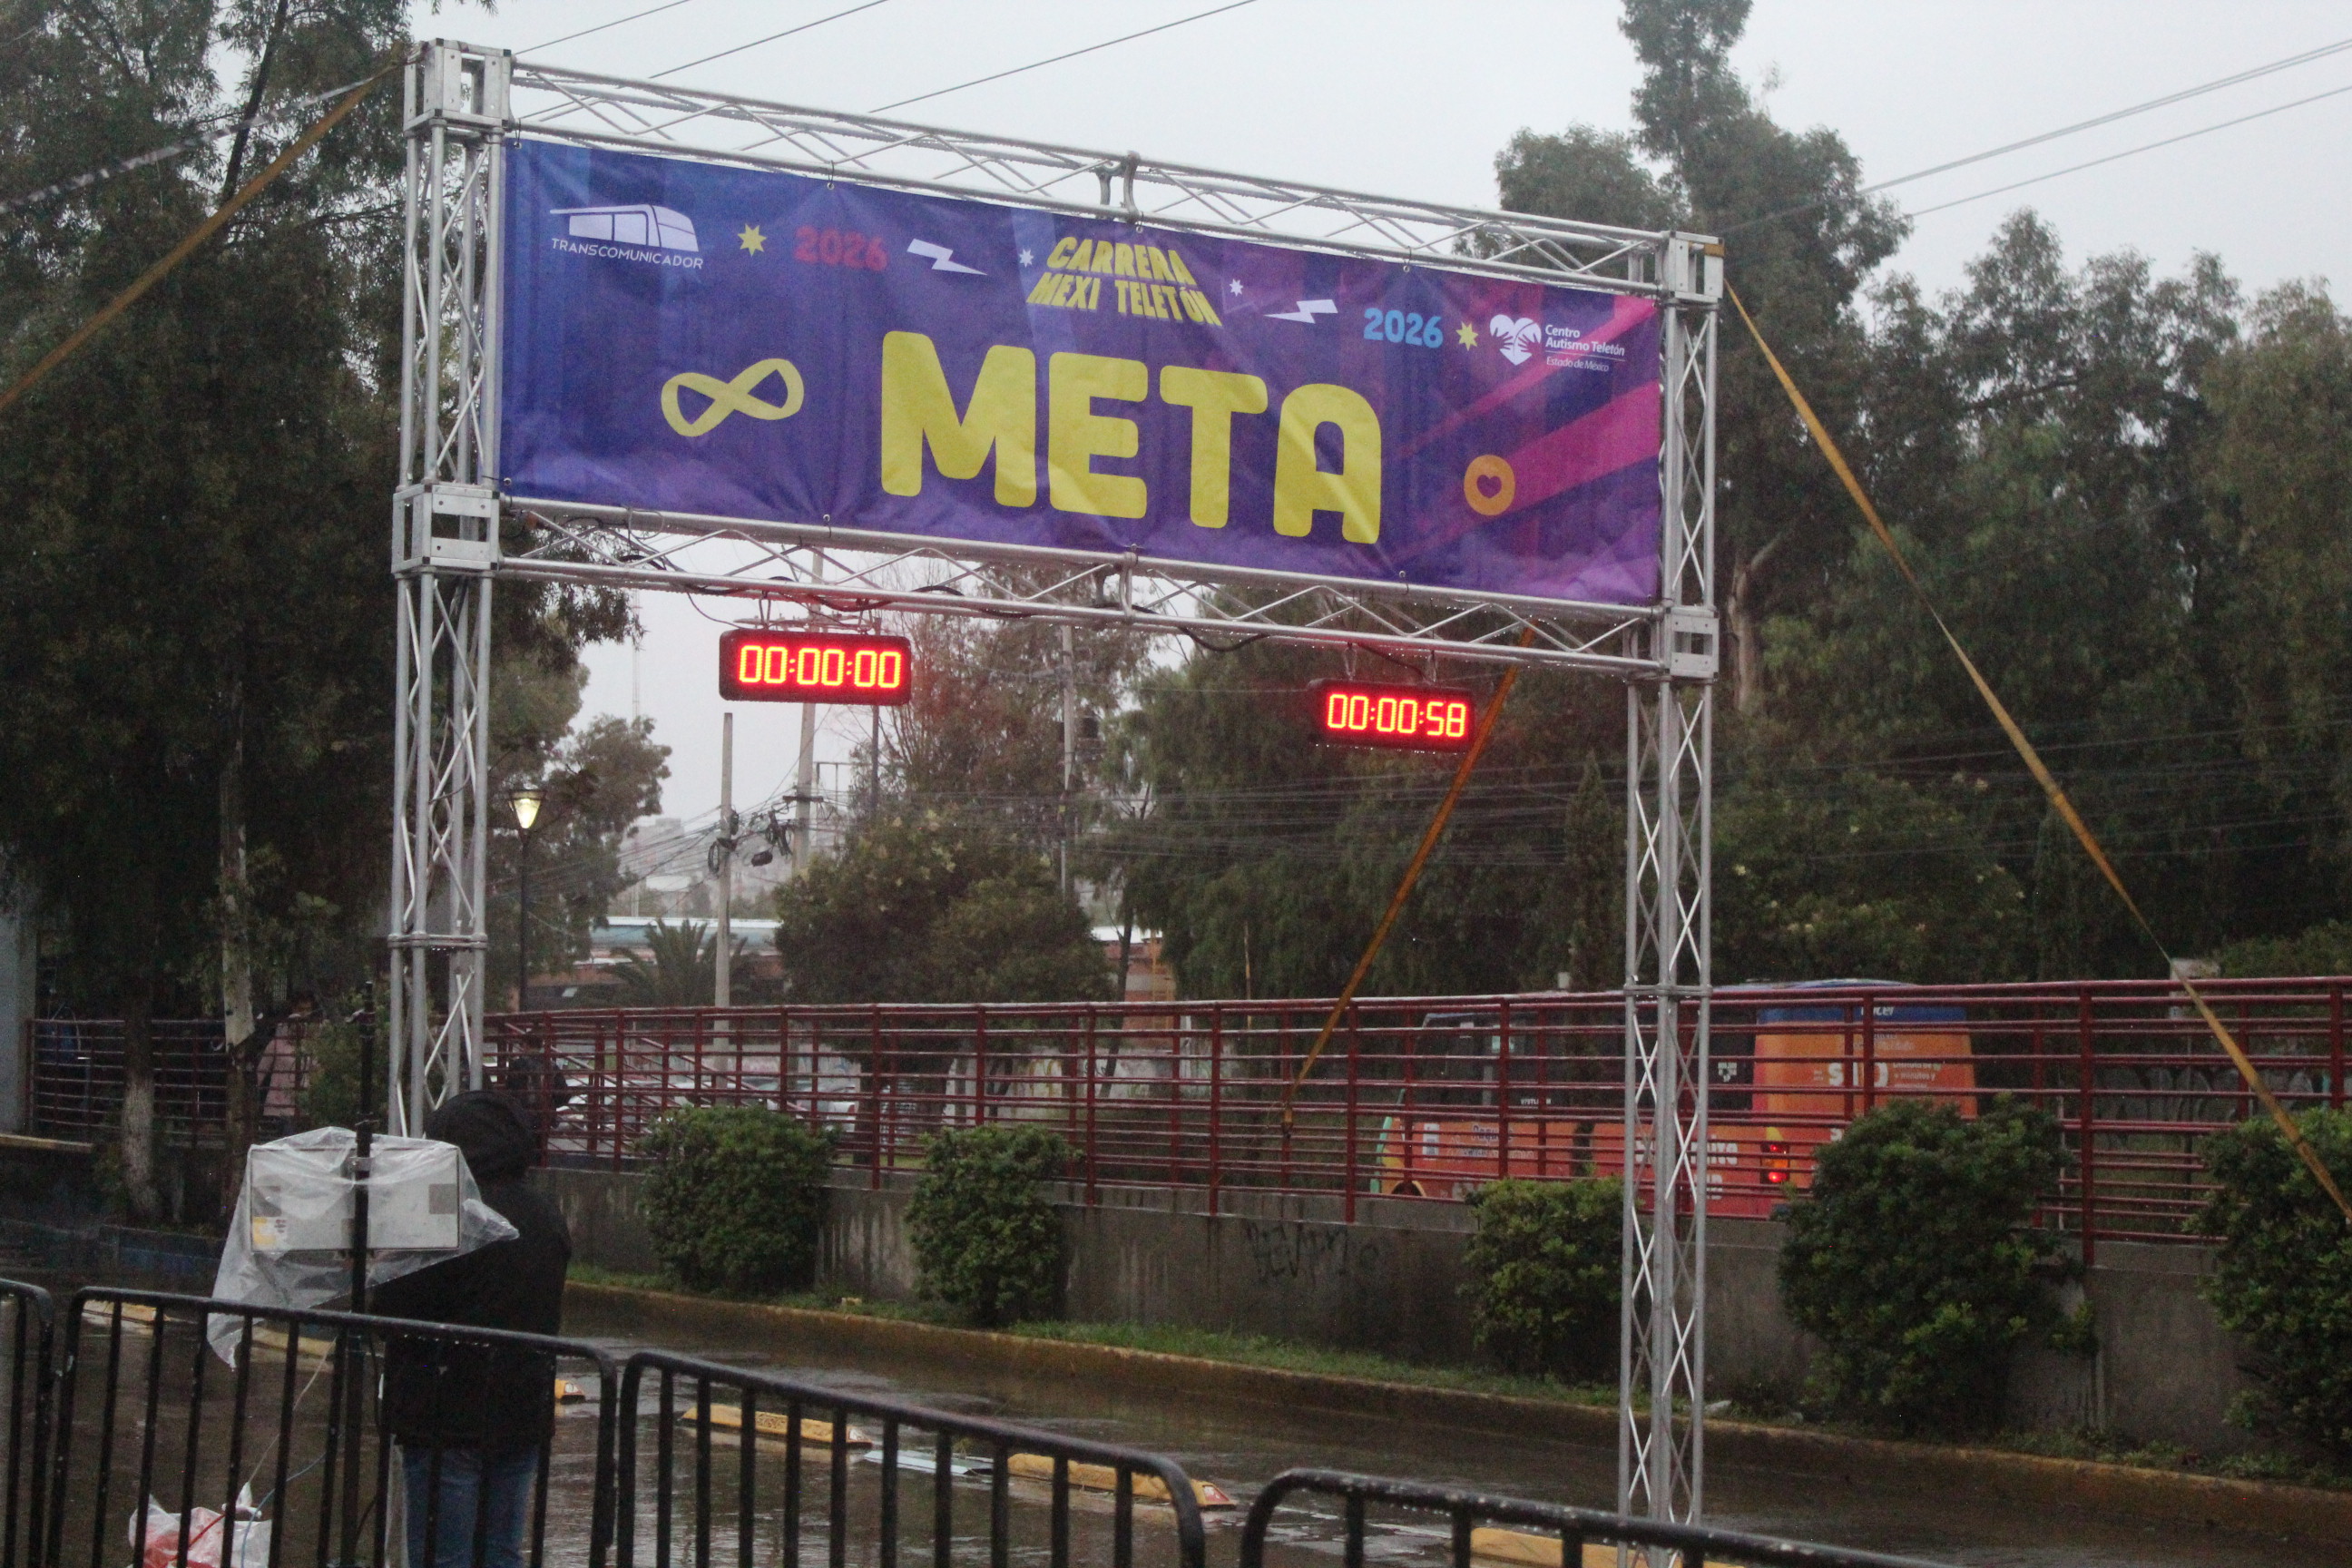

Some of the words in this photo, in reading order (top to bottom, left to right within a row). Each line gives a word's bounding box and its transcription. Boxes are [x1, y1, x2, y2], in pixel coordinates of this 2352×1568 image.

[551, 237, 704, 270] TRANSCOMUNICADOR
[793, 225, 888, 271] 2026
[1046, 236, 1198, 286] CARRERA
[1025, 271, 1102, 310] MEXI
[1114, 279, 1223, 327] TELETÓN
[1363, 307, 1445, 348] 2026
[1544, 323, 1581, 338] Centro
[1544, 337, 1590, 351] Autismo
[1591, 340, 1625, 357] Teletón
[1546, 356, 1573, 368] Estado
[1573, 359, 1586, 369] de
[1585, 360, 1610, 372] México
[880, 329, 1382, 544] META
[738, 644, 902, 689] 00:00:00
[1327, 693, 1467, 738] 00:00:58
